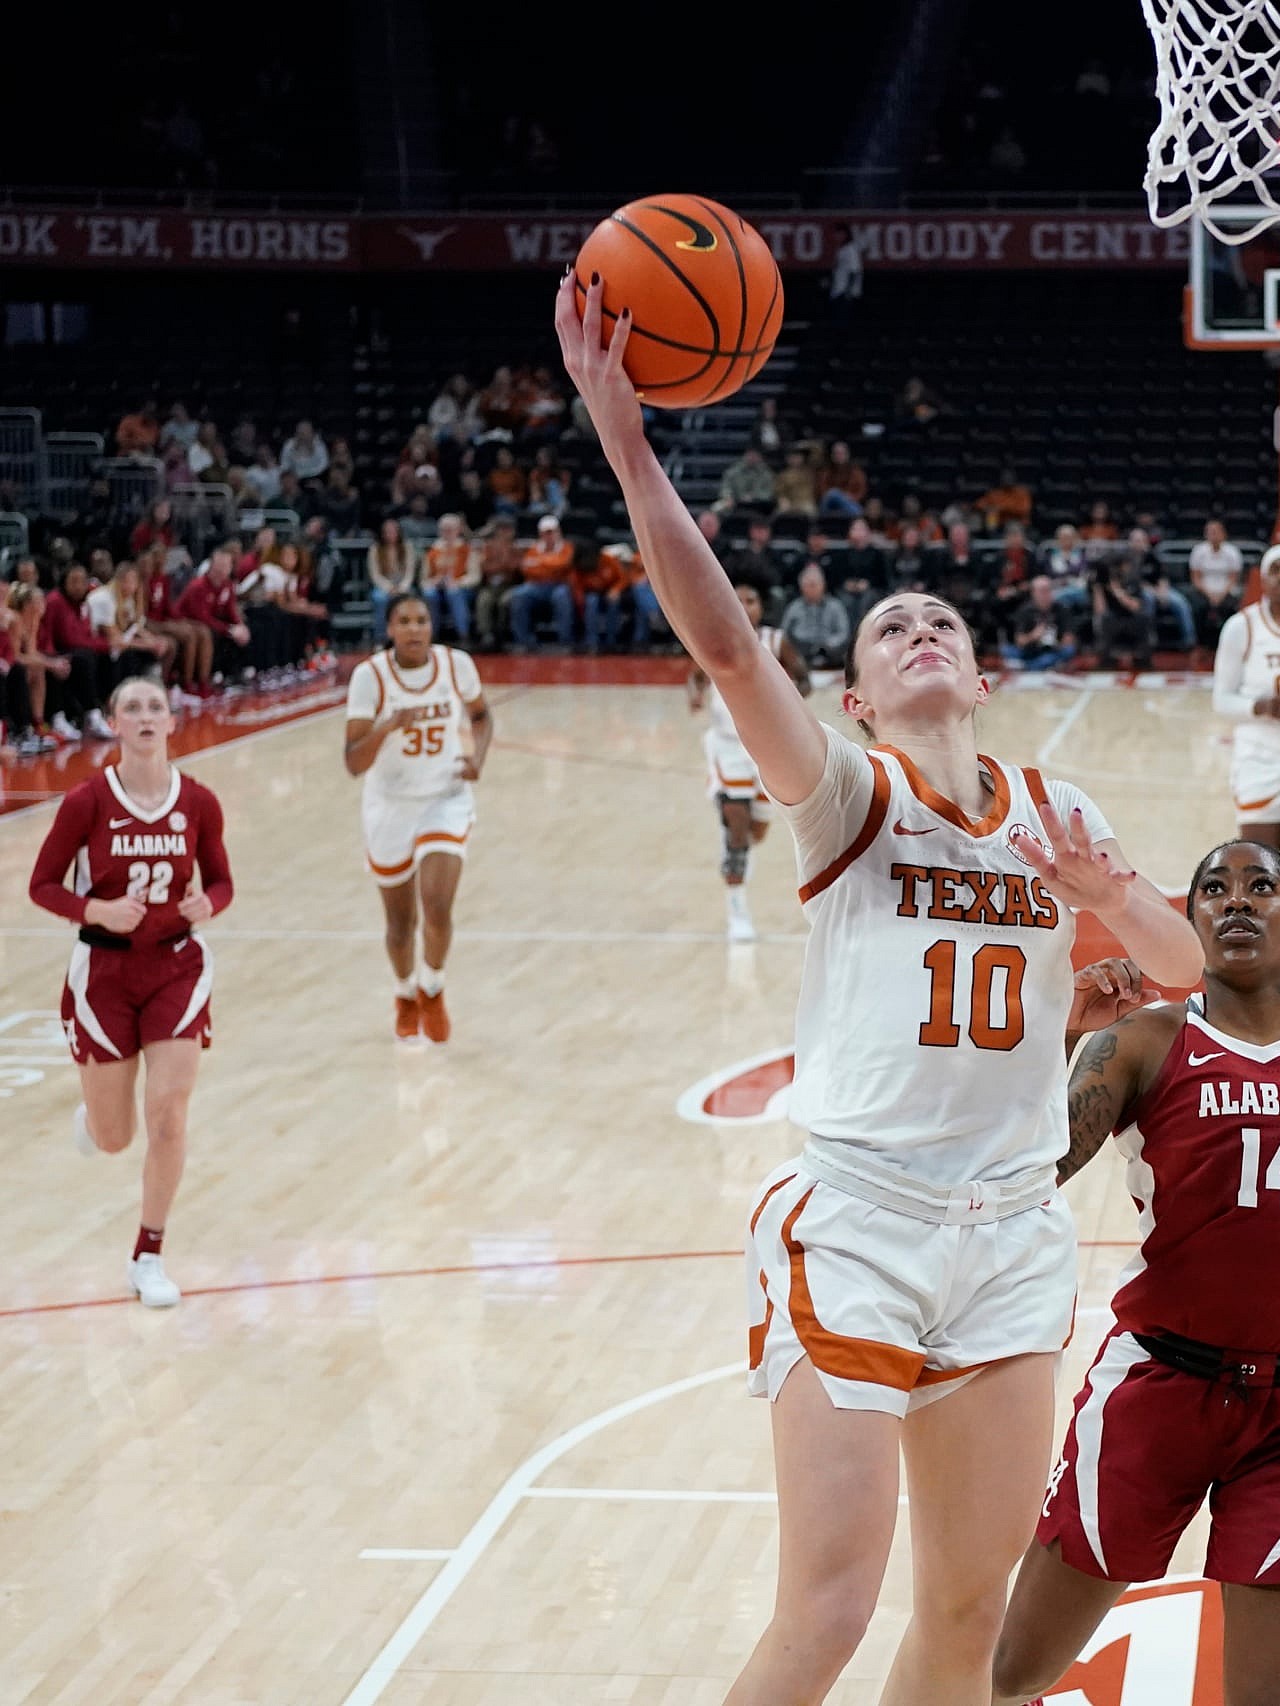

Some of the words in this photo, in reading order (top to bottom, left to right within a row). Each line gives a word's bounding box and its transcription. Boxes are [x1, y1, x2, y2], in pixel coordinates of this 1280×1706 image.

[191, 218, 349, 261] HORNS
[504, 223, 593, 262] WE
[762, 222, 825, 261] TO
[850, 221, 1013, 260] MOODY
[1030, 221, 1191, 261] CENTE
[402, 725, 445, 756] 35
[111, 834, 187, 857] ALABAMA
[126, 861, 174, 904] 22
[890, 862, 1059, 930] TEXAS
[918, 939, 1027, 1052] 10
